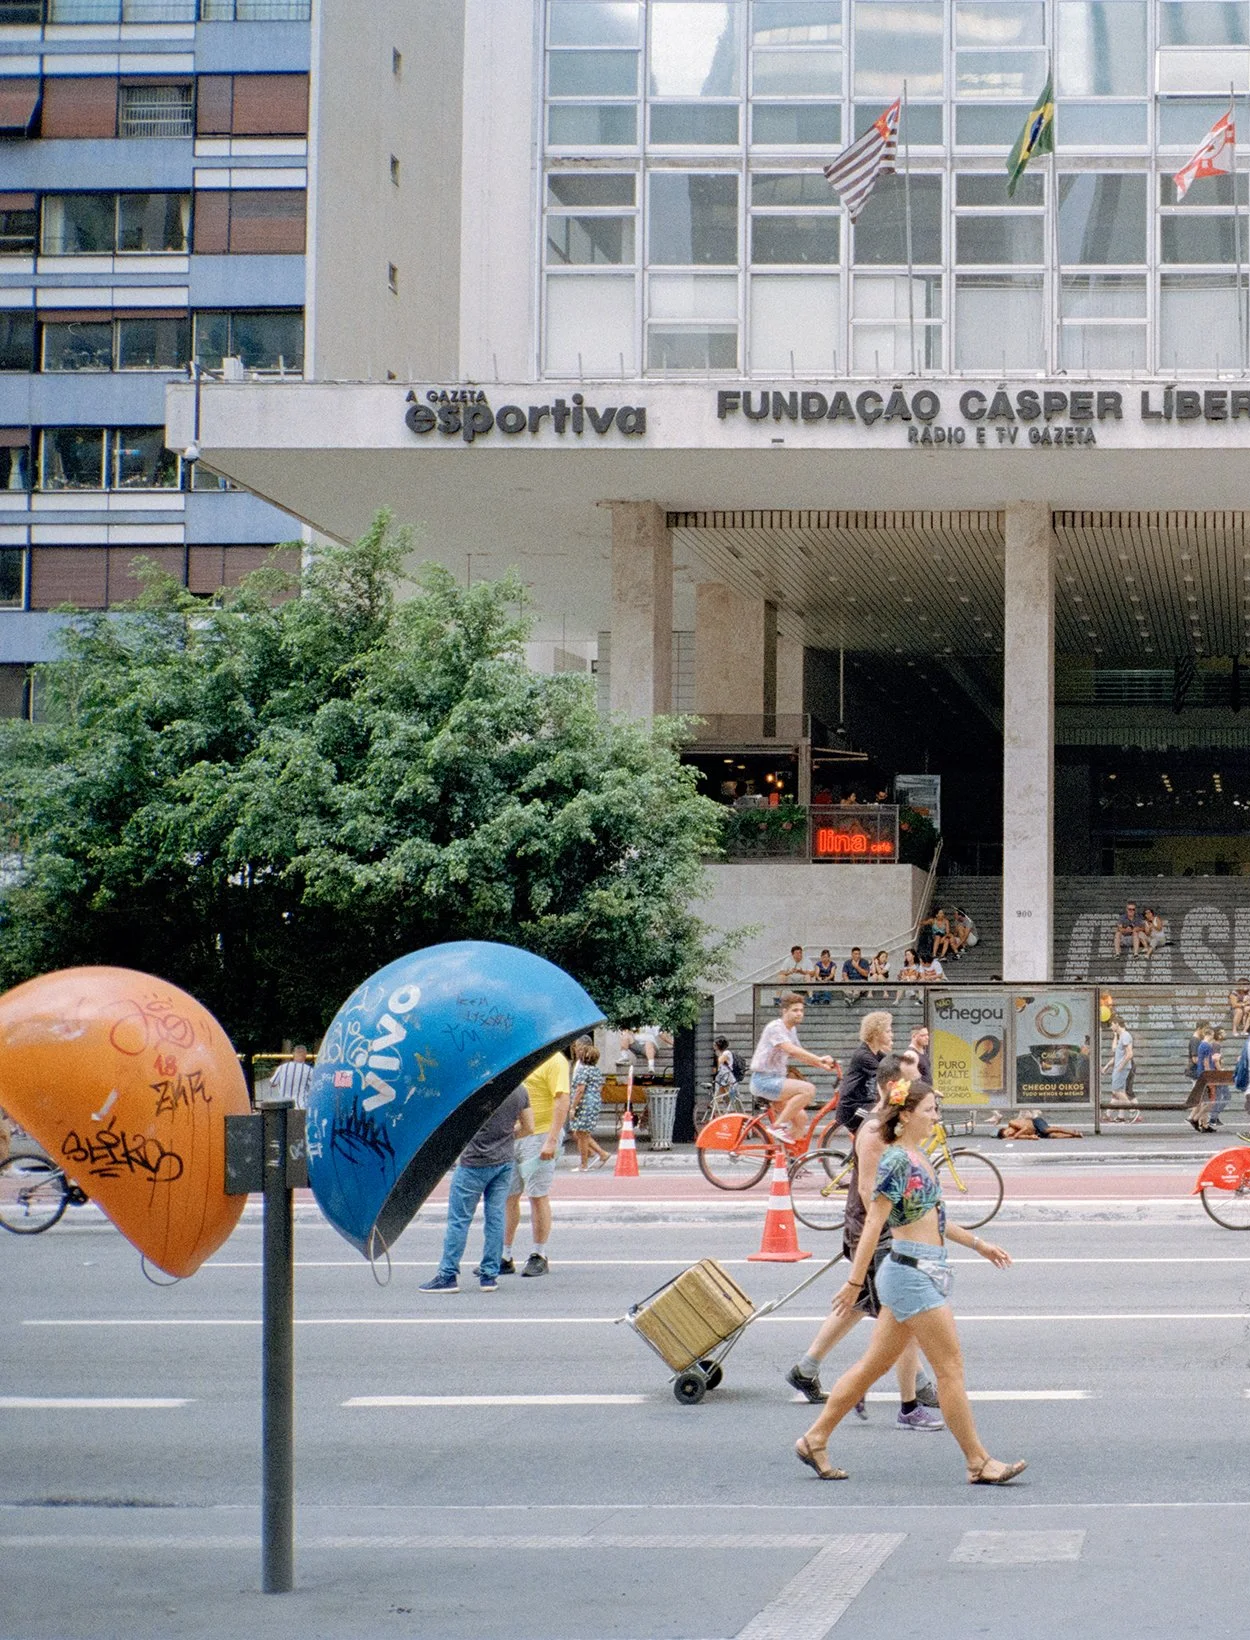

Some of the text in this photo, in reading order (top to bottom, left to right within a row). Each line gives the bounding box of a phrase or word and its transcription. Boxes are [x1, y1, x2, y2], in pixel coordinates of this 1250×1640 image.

[405, 390, 487, 403] A GAZETA
[717, 384, 941, 425] FUNDAÇÃO
[959, 383, 1123, 420] CÁSPER
[405, 393, 647, 442] esportiva
[976, 427, 986, 444] E
[996, 427, 1019, 444] TV
[1028, 427, 1097, 444] GAZETA
[819, 829, 867, 852] lina
[940, 1007, 1004, 1025] chegou
[938, 1061, 966, 1070] PURO
[938, 1070, 969, 1079] MALTE
[1022, 1083, 1084, 1091] CHEGOU OIKOS
